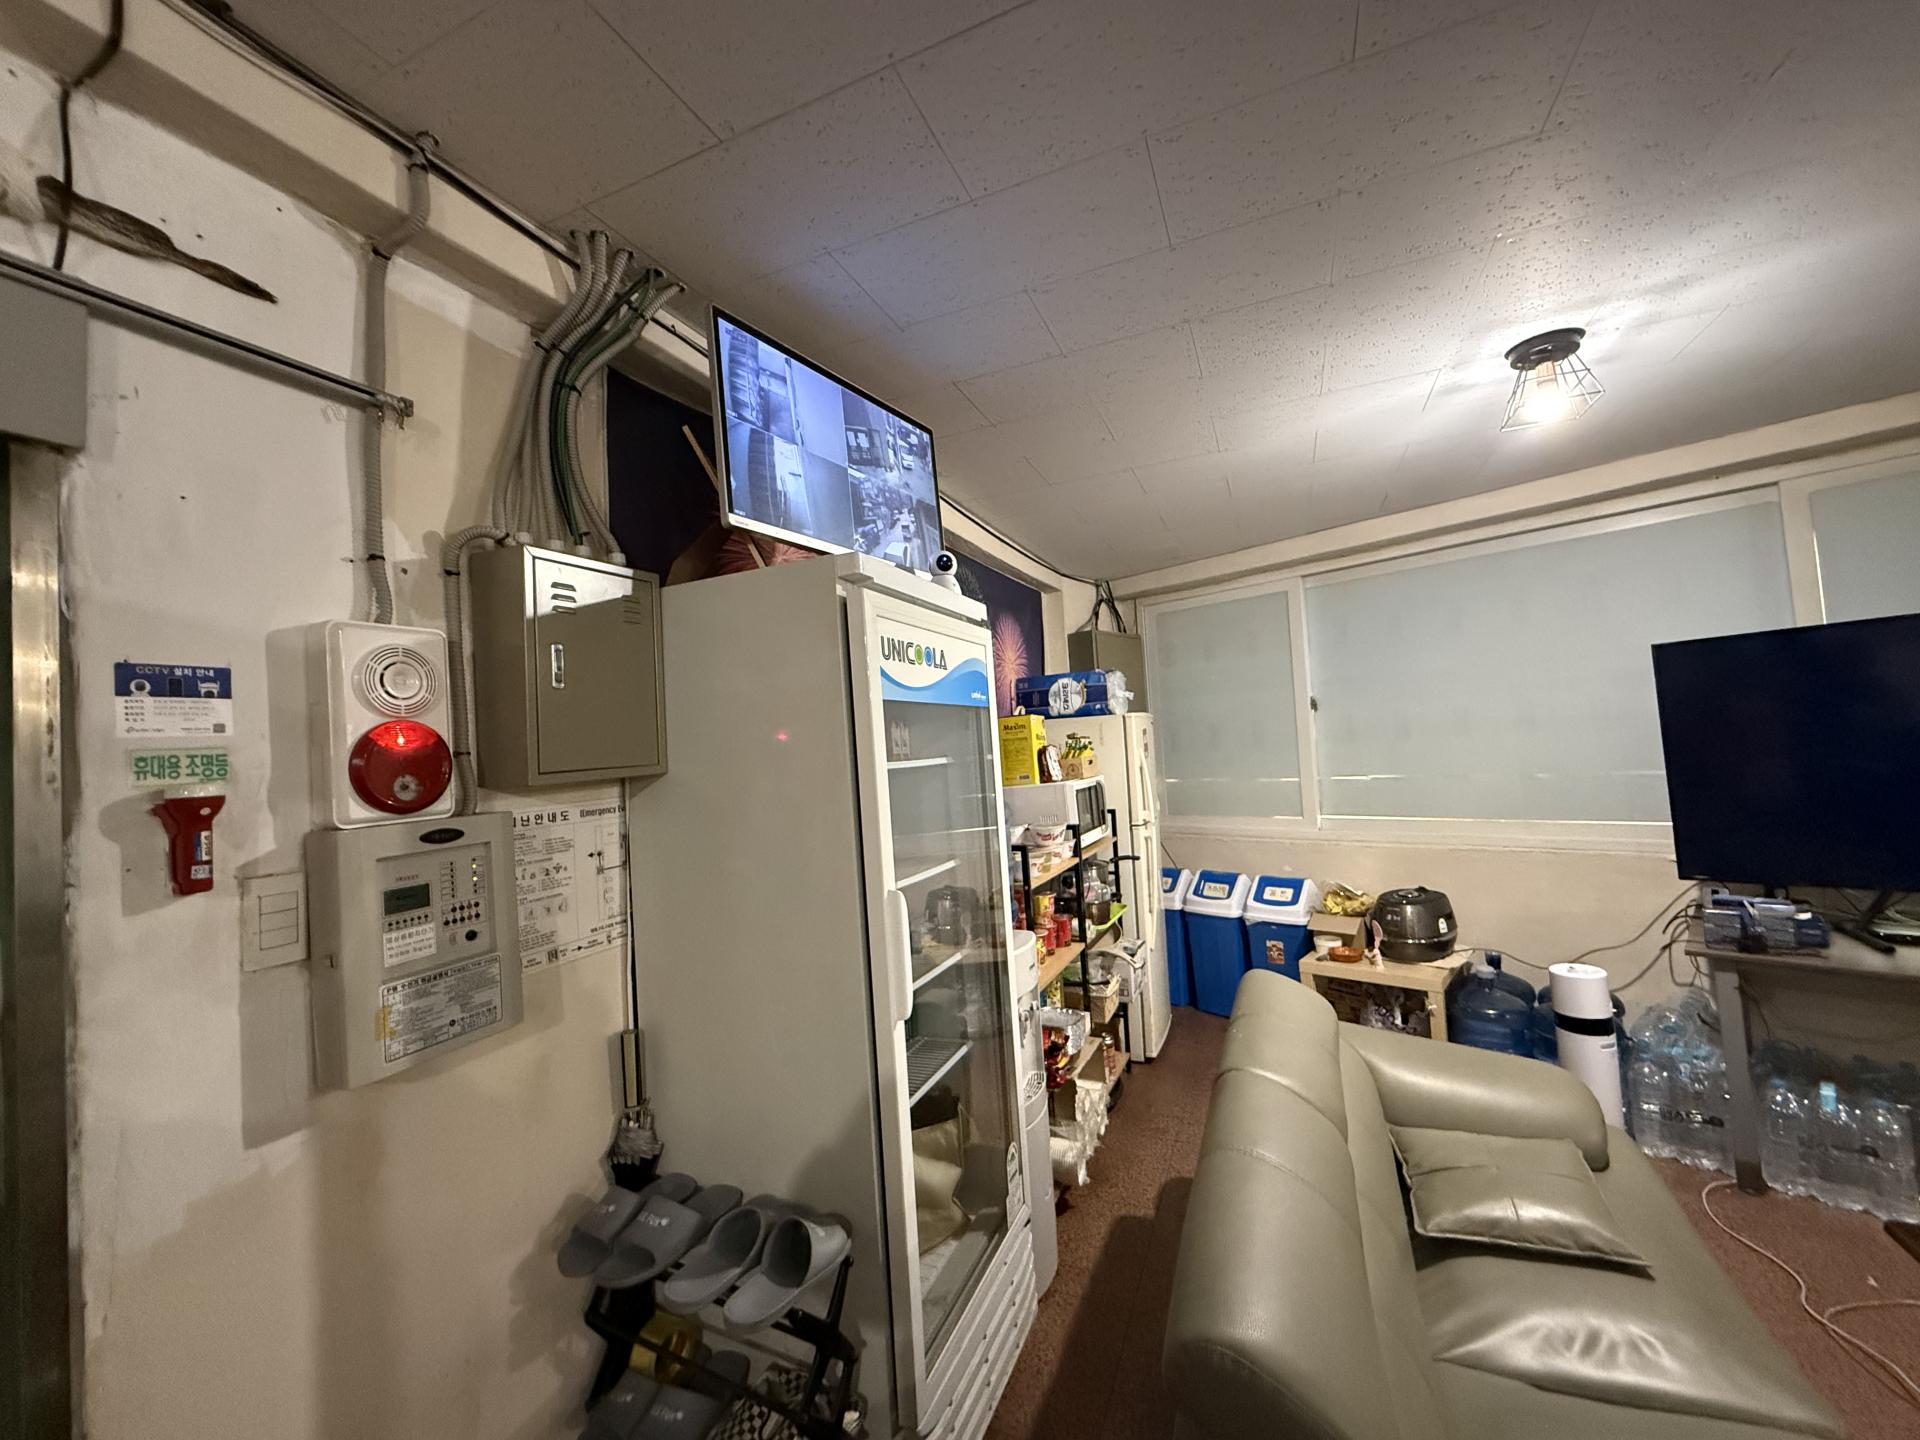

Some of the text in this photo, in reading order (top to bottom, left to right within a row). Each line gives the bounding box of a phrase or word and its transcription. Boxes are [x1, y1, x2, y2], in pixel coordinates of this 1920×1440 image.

[881, 635, 947, 670] UNICOOLA
[136, 666, 170, 674] CCTV
[173, 667, 193, 676] 설치
[1003, 722, 1026, 731] Maxim
[133, 753, 229, 780] 휴대용 조명등
